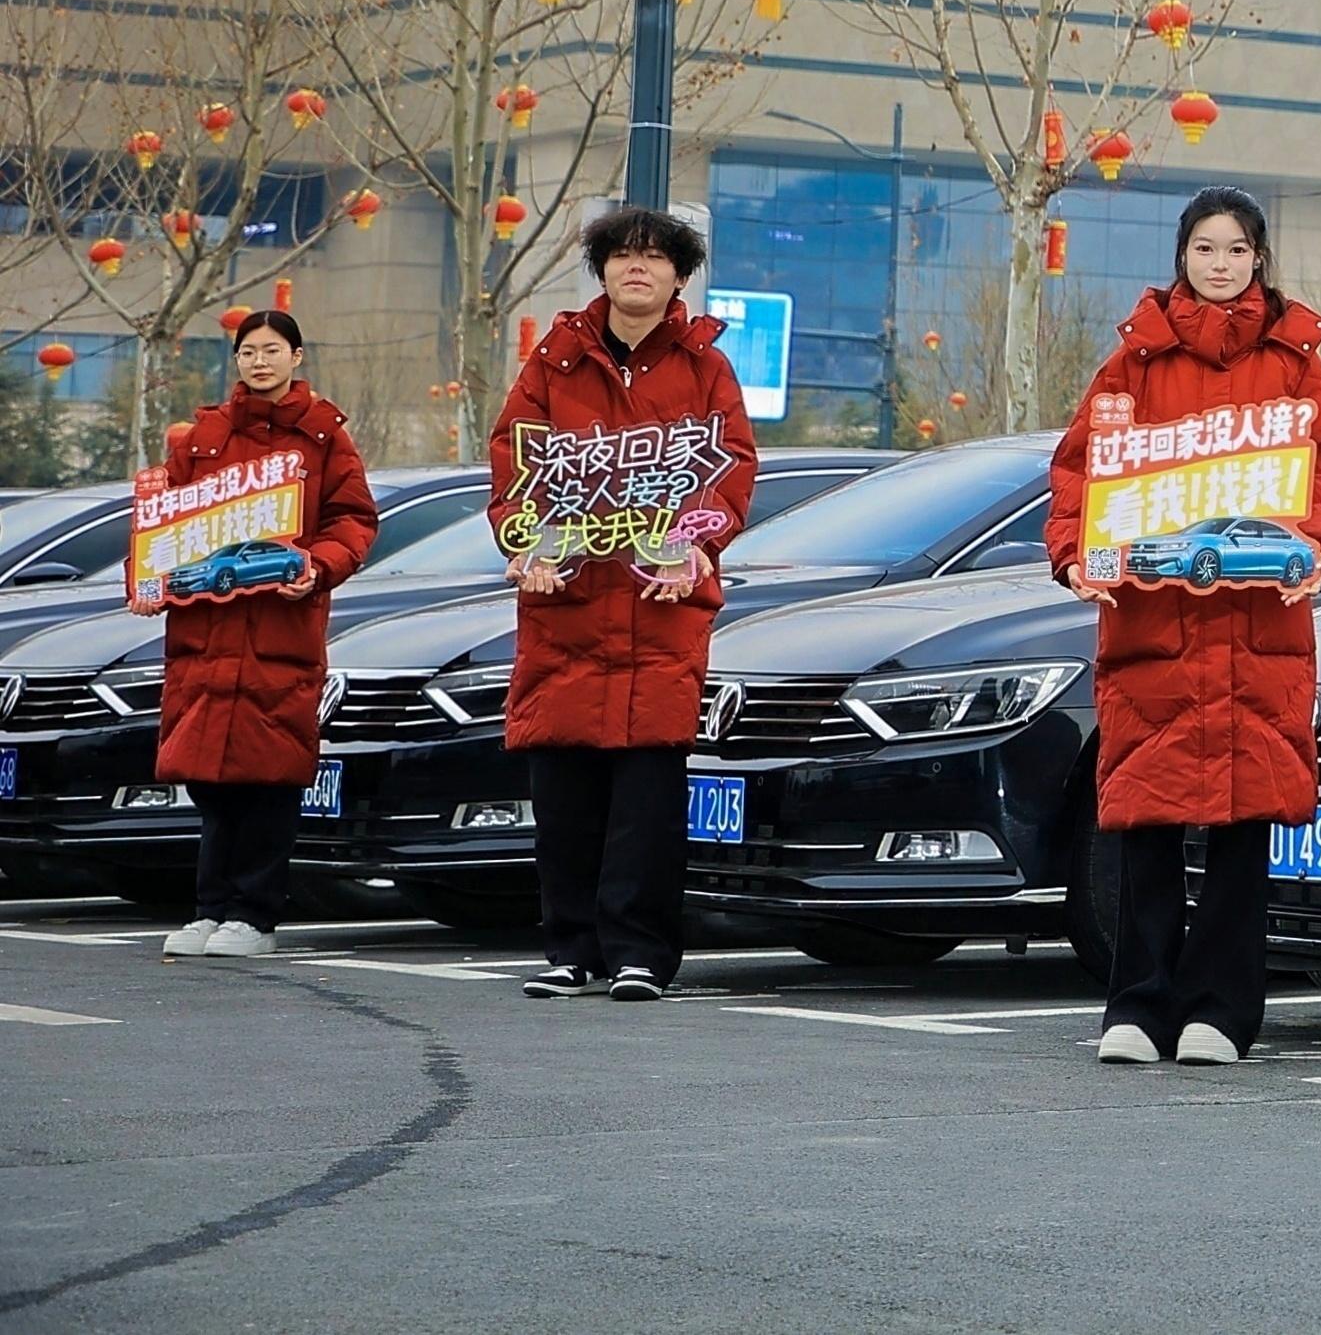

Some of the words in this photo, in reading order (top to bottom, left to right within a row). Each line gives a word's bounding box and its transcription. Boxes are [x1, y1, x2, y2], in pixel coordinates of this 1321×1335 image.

[523, 419, 714, 499] 深夜回家
[1092, 402, 1313, 478] 过年回家没人接?
[136, 453, 300, 530] 过年回家没人接?
[537, 466, 698, 529] 没人接?
[1096, 456, 1301, 543] 看我!找我!
[142, 492, 293, 576] 看我!找我!
[540, 508, 685, 565] 找我!
